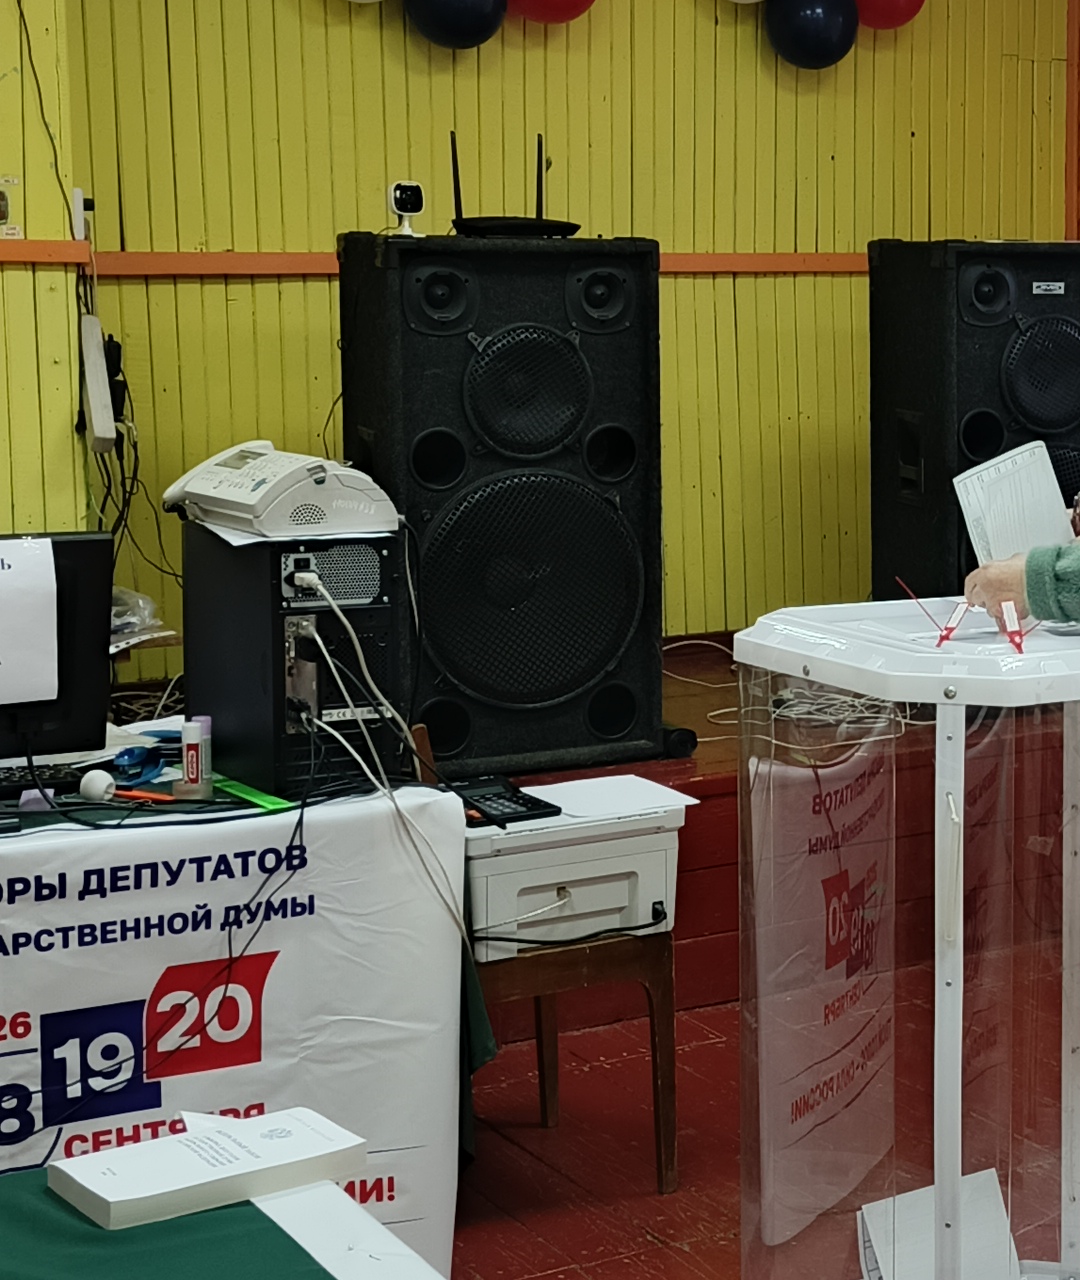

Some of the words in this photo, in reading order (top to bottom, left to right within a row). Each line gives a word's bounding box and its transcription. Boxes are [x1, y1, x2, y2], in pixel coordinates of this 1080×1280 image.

[0, 871, 67, 905] РЫ
[78, 845, 308, 900] ДЕПУТАТОВ
[220, 894, 315, 931] ДУМЫ
[156, 983, 253, 1053] 20
[54, 1032, 135, 1099] 19
